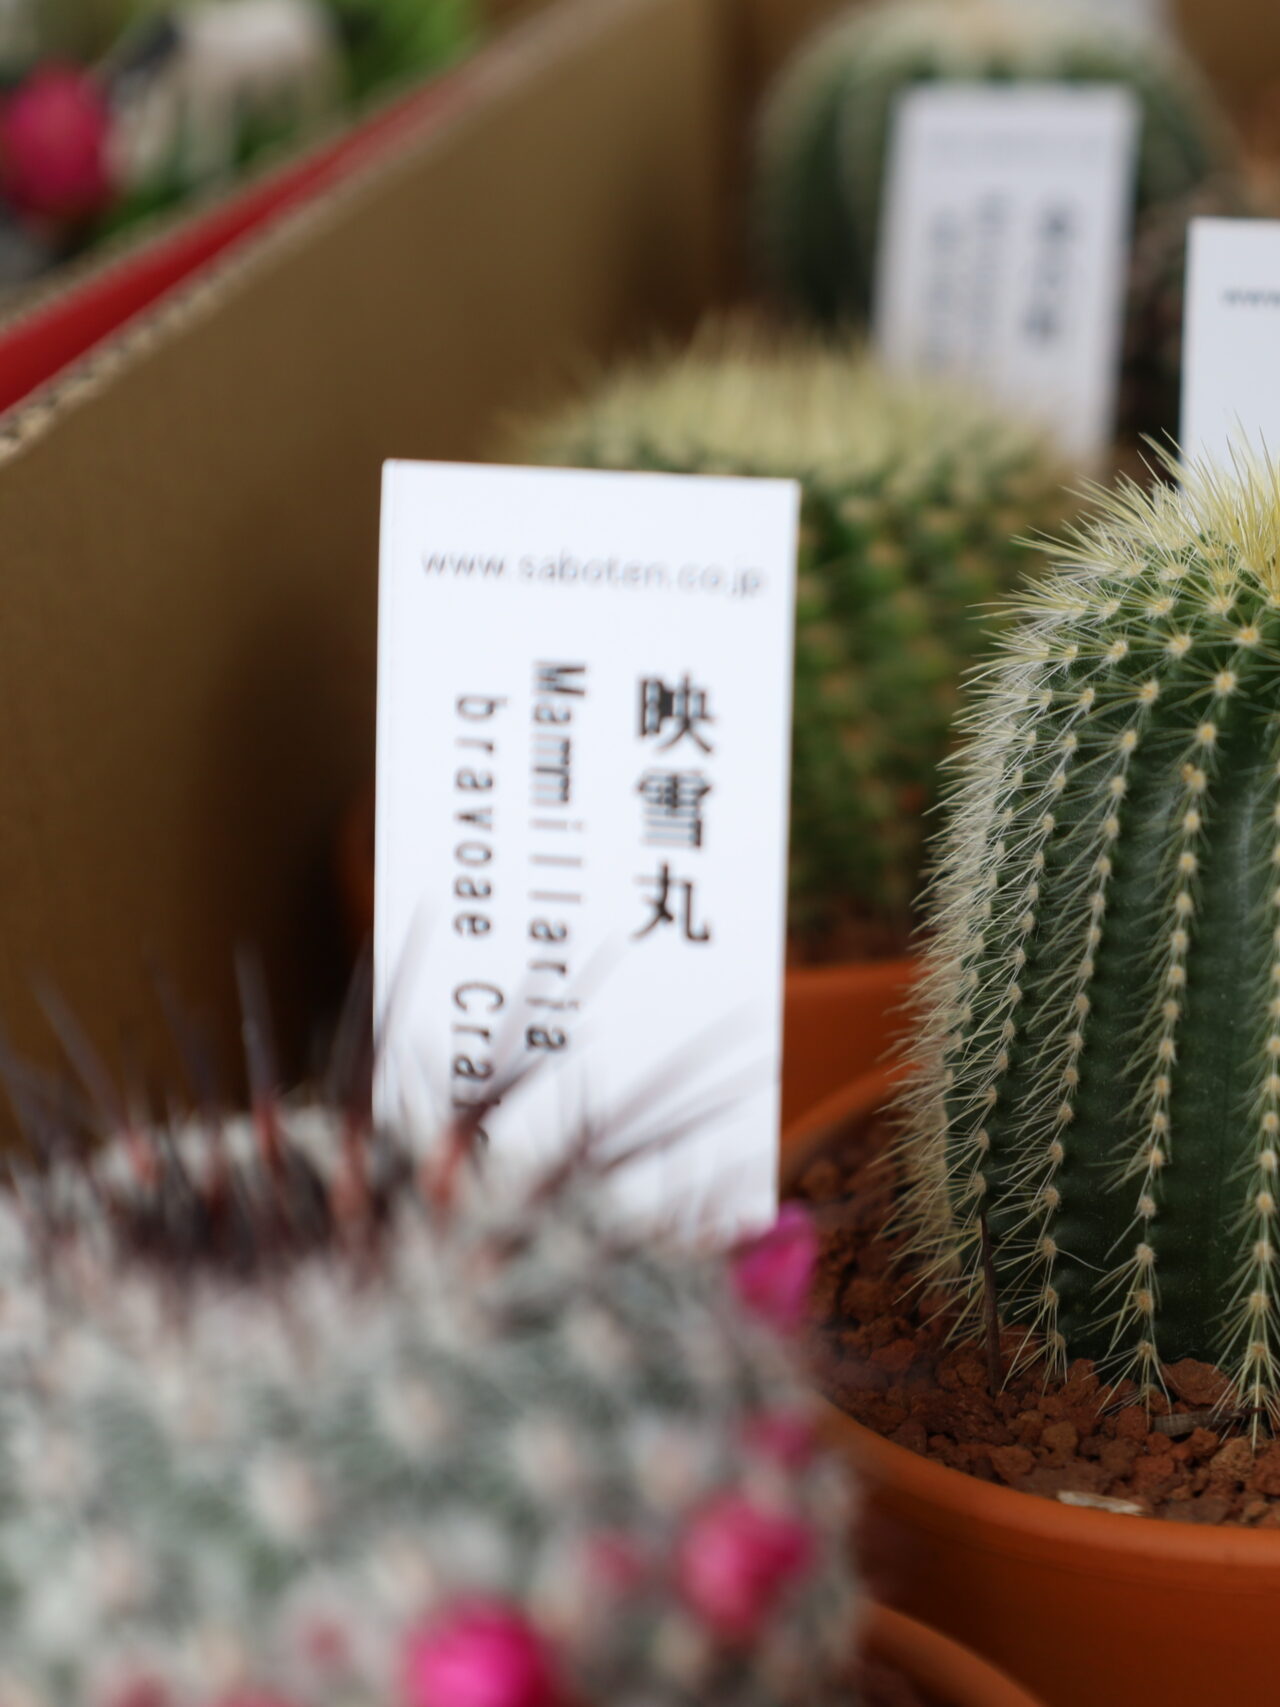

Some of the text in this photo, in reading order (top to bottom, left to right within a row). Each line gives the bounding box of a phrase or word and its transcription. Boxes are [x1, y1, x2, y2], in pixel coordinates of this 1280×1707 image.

[422, 548, 769, 600] www.saboten.co.jp
[453, 693, 508, 939] bravoae
[526, 660, 588, 1053] Mammillaria
[633, 672, 717, 944] 映雪丸
